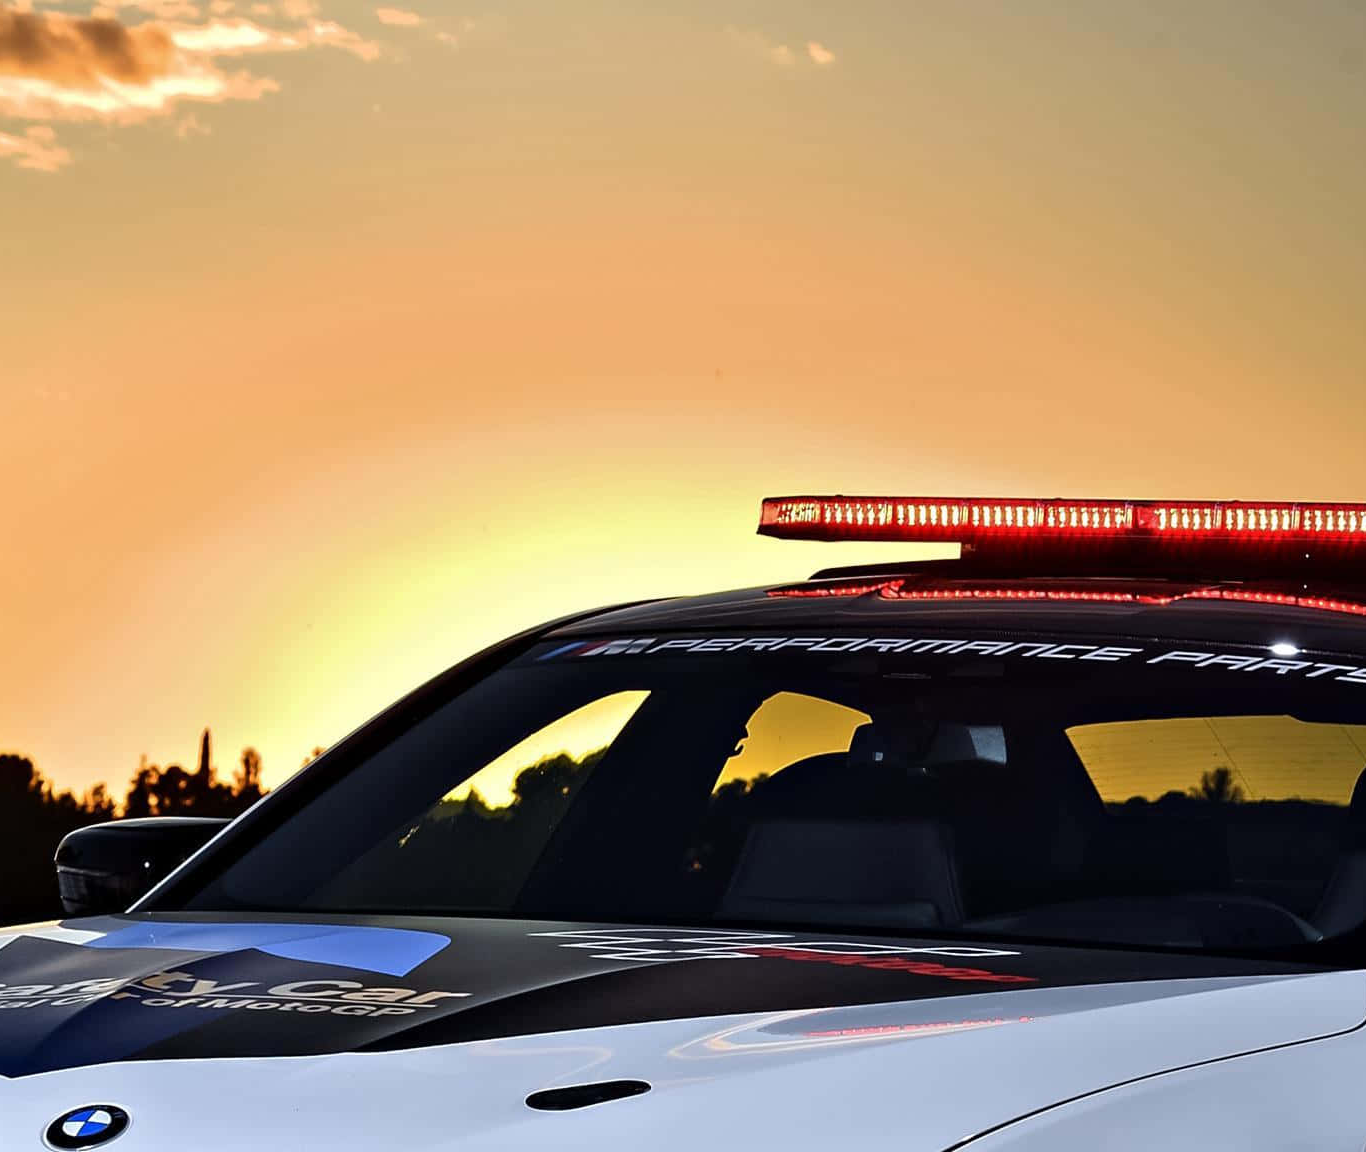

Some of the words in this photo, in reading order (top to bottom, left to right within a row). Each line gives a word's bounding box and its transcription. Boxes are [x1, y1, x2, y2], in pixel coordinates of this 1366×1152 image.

[646, 638, 1144, 662] PERFORMANCE
[267, 979, 473, 1003] Car
[141, 998, 204, 1009] of
[197, 997, 417, 1017] MotoGP
